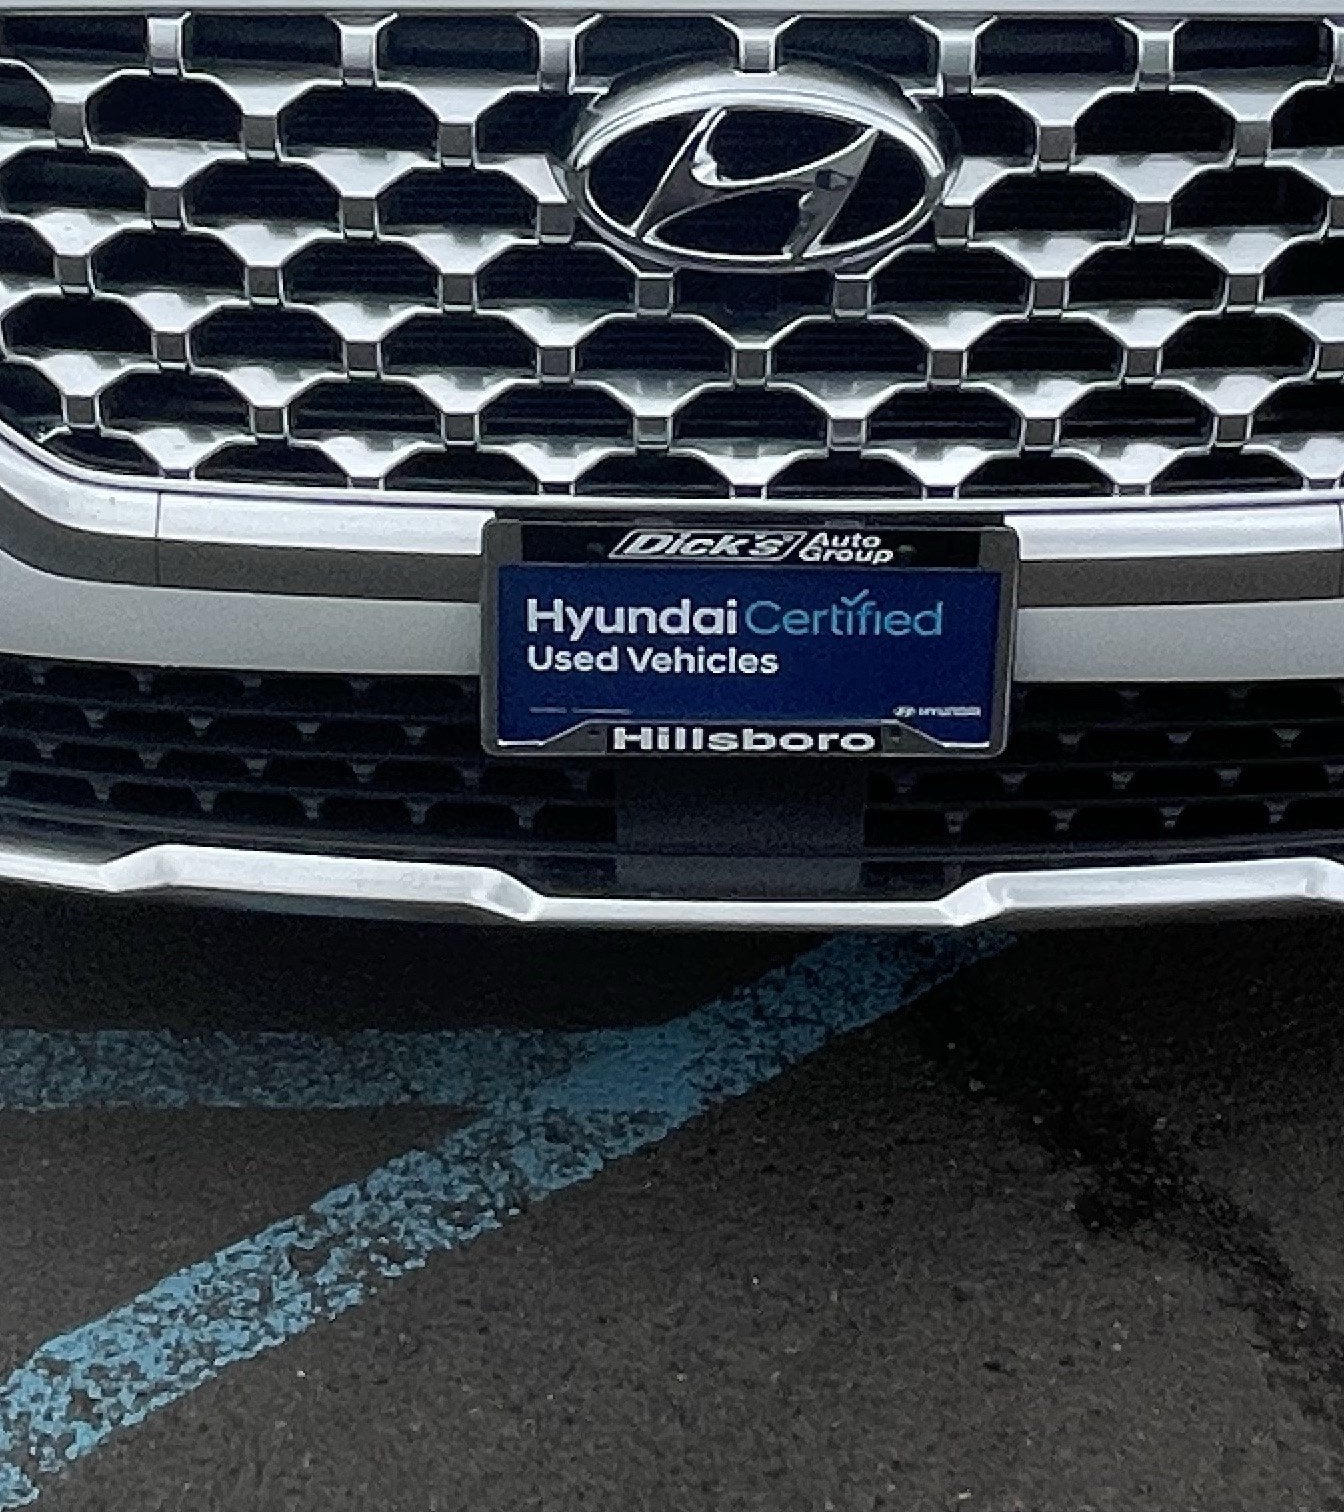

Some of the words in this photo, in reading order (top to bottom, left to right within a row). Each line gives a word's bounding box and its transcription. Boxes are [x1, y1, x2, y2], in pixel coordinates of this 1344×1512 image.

[800, 532, 882, 548] Auto
[798, 547, 894, 565] Group
[527, 599, 738, 641] Hyundai
[744, 589, 943, 636] Certified
[528, 646, 618, 672] Used
[626, 646, 779, 674] Vehicles
[612, 727, 876, 752] Hillsboro
